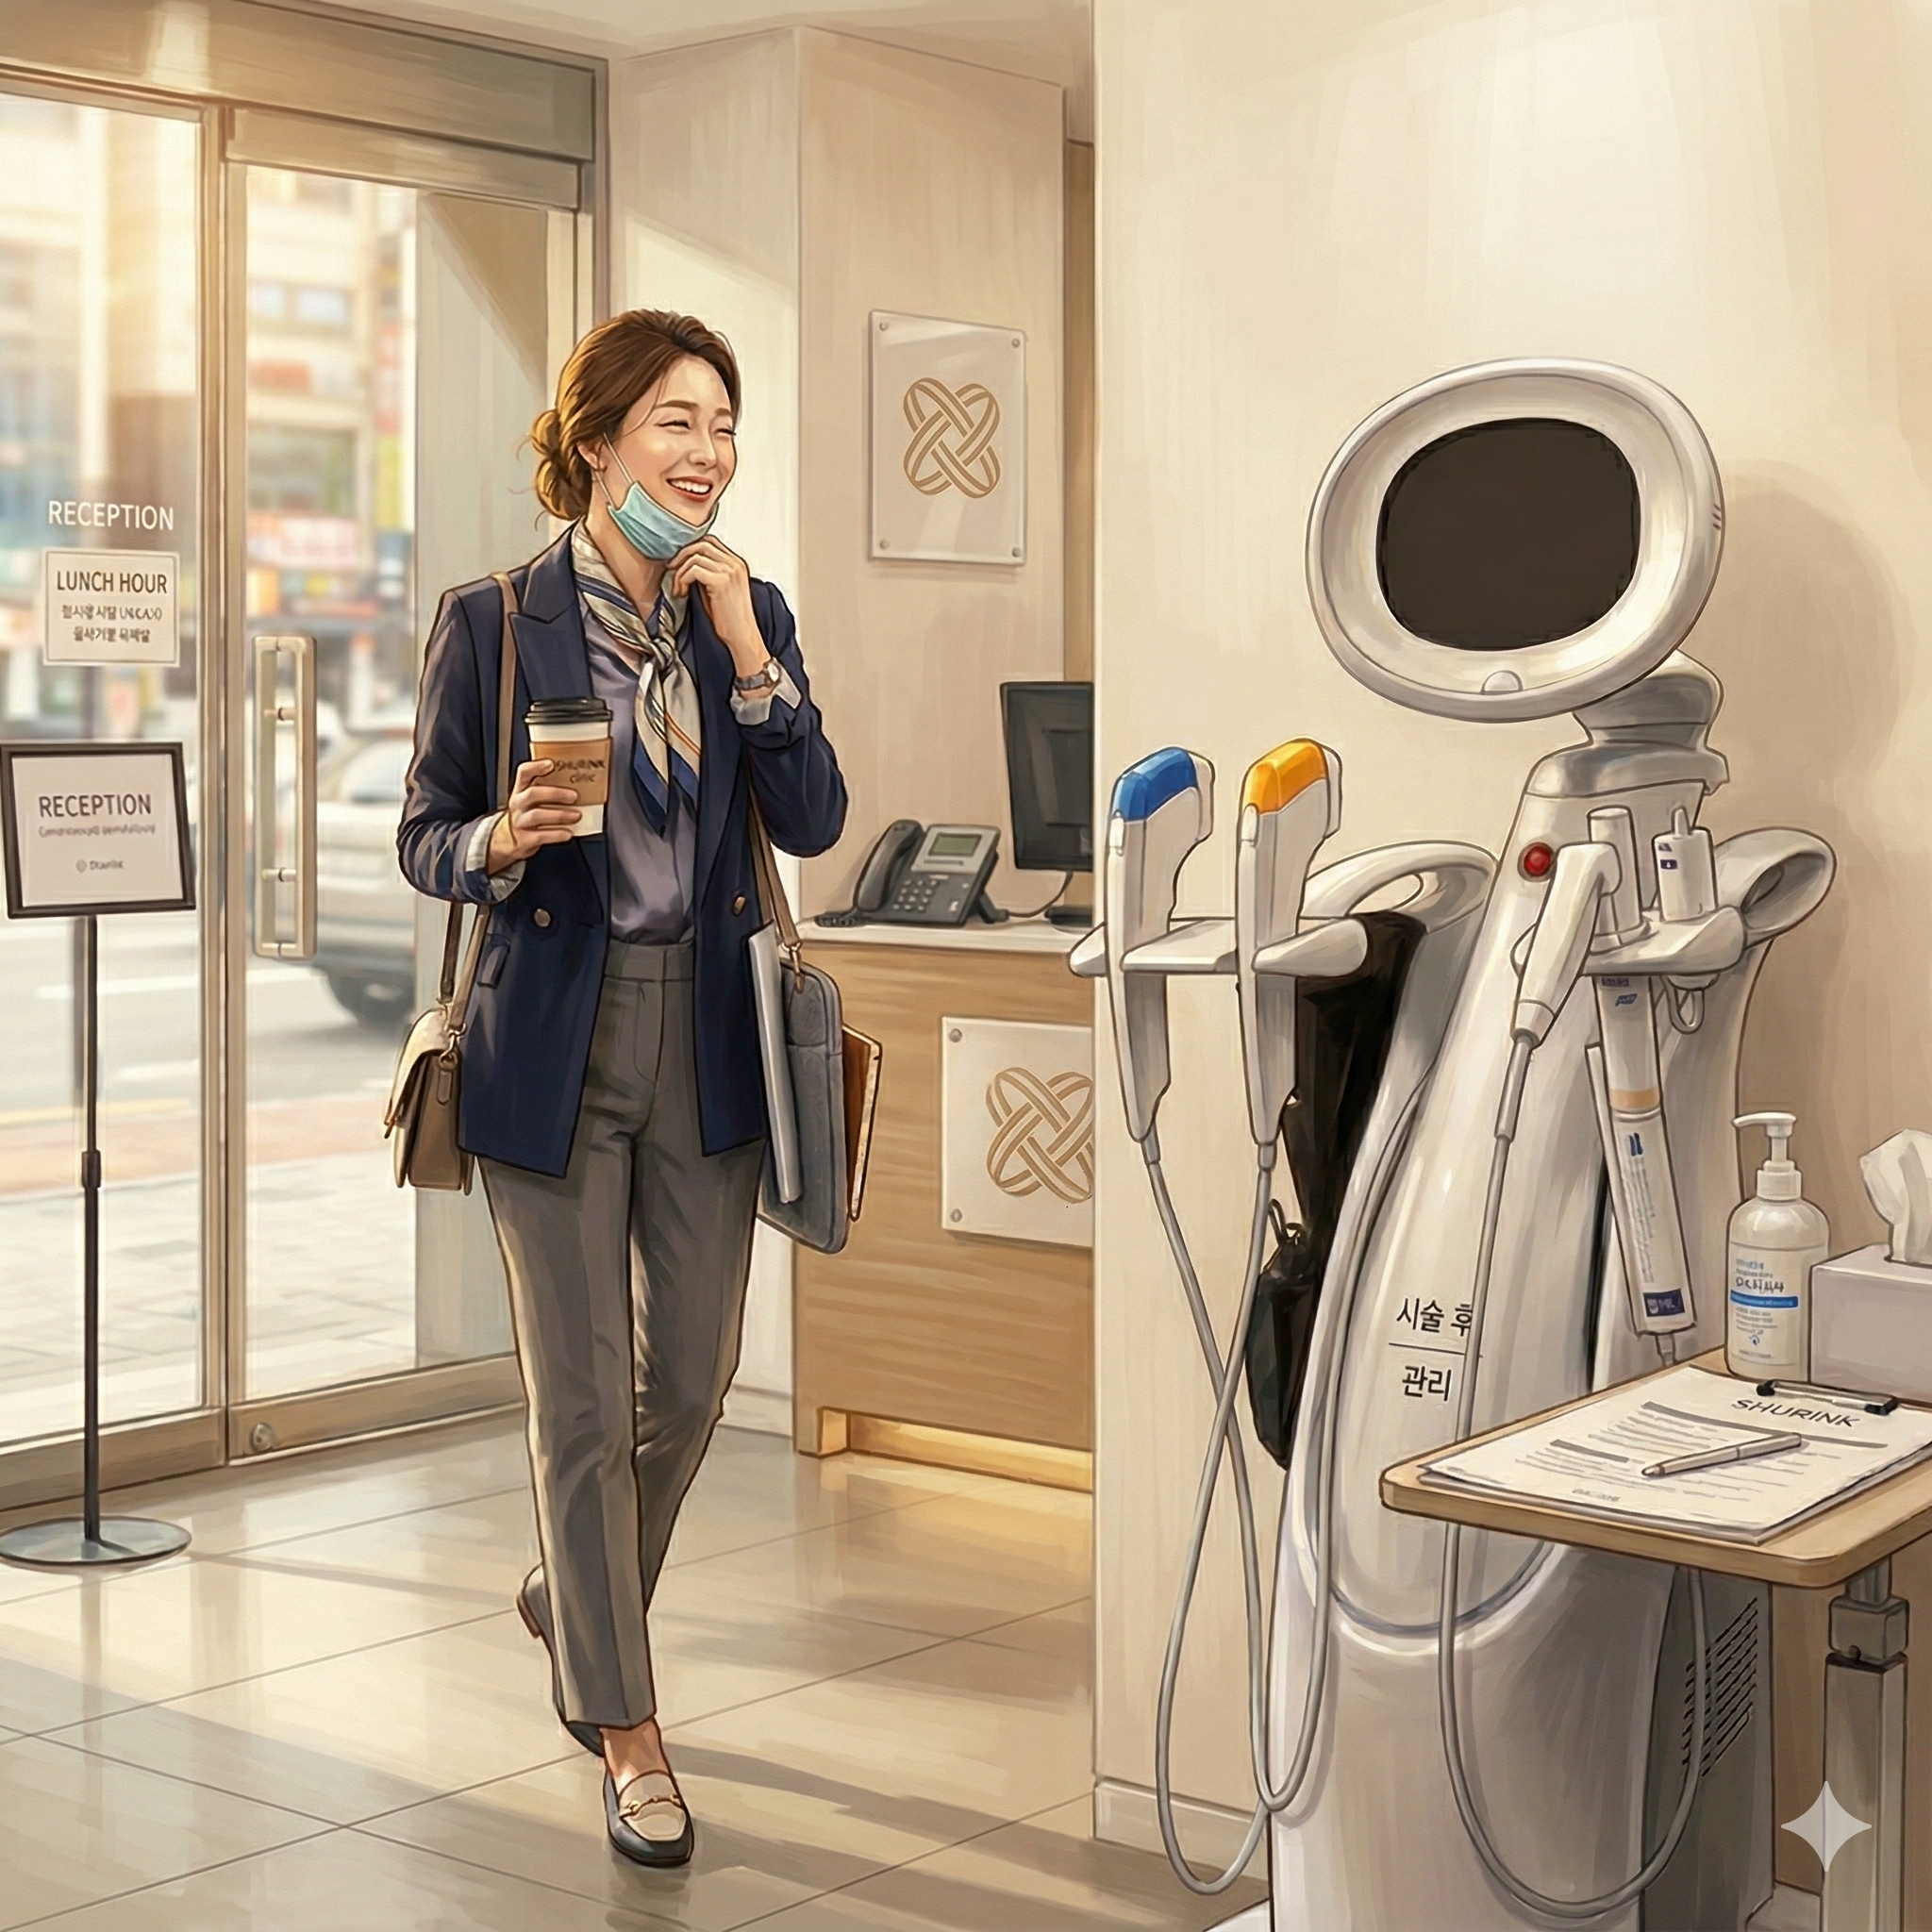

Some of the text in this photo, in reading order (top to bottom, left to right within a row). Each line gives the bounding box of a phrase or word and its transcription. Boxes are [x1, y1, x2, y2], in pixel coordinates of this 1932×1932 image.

[48, 500, 174, 530] RECEPTION
[57, 571, 168, 594] LUNCH HOUR
[39, 793, 152, 818] RECEPTION
[1396, 1297, 1474, 1337] 시술 후
[1402, 1365, 1452, 1402] 관리
[1731, 1399, 1860, 1427] SHURINK
